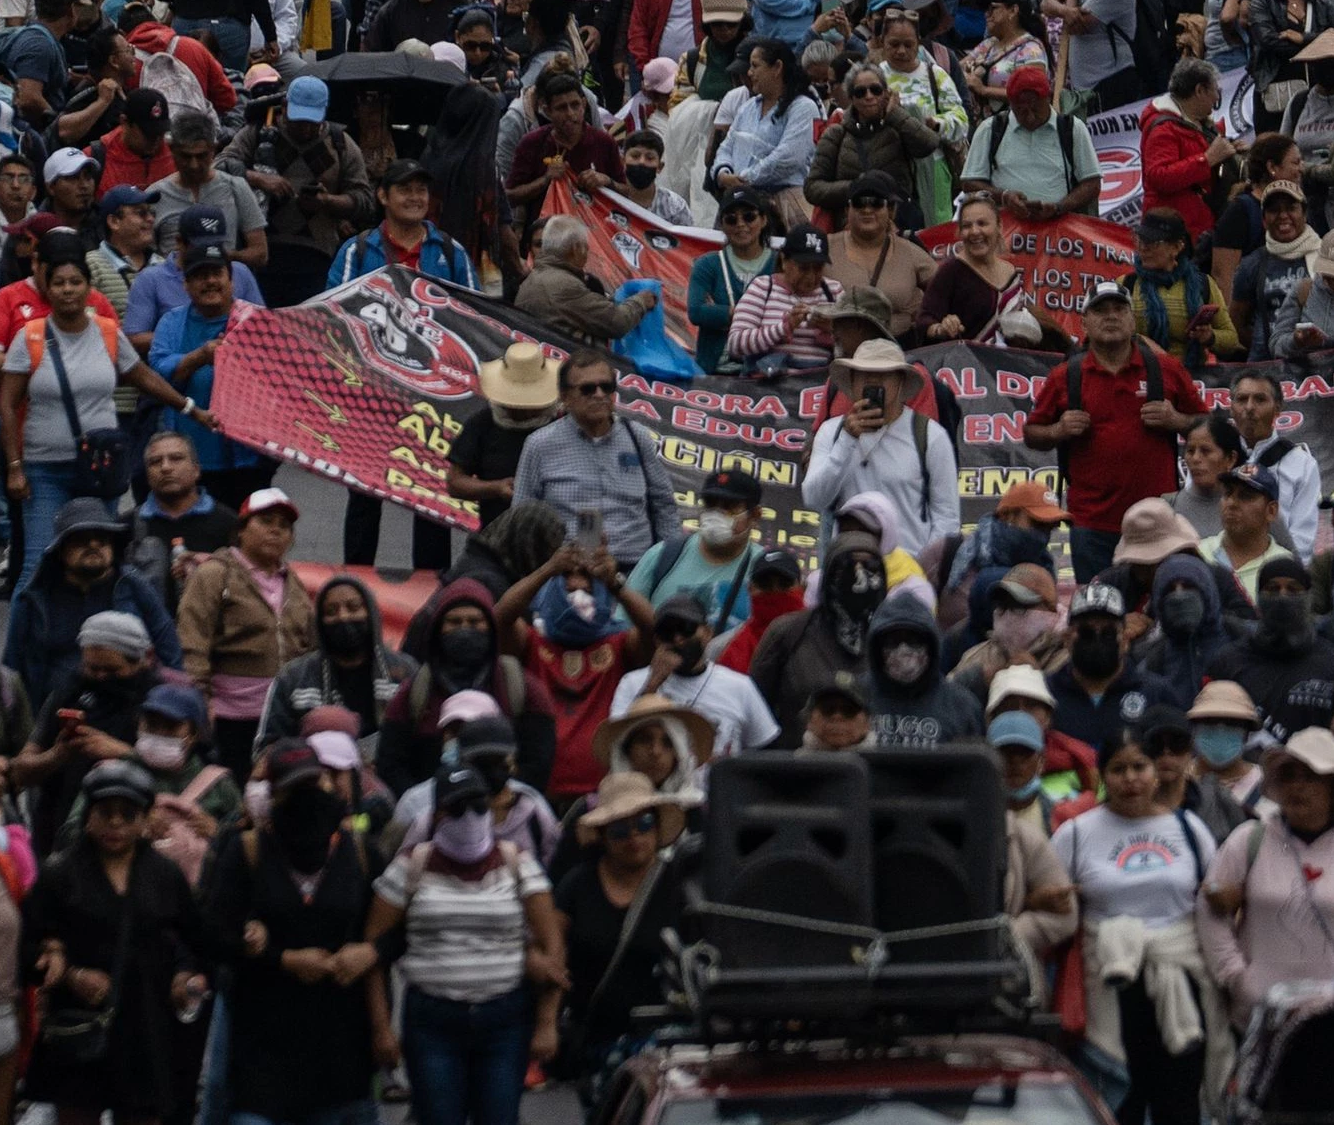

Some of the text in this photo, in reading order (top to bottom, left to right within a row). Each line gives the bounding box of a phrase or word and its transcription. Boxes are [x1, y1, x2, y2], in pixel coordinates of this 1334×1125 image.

[1011, 233, 1037, 253] DE
[1044, 235, 1084, 258] LOS
[1034, 268, 1071, 289] LOS
[1045, 295, 1085, 313] GUE
